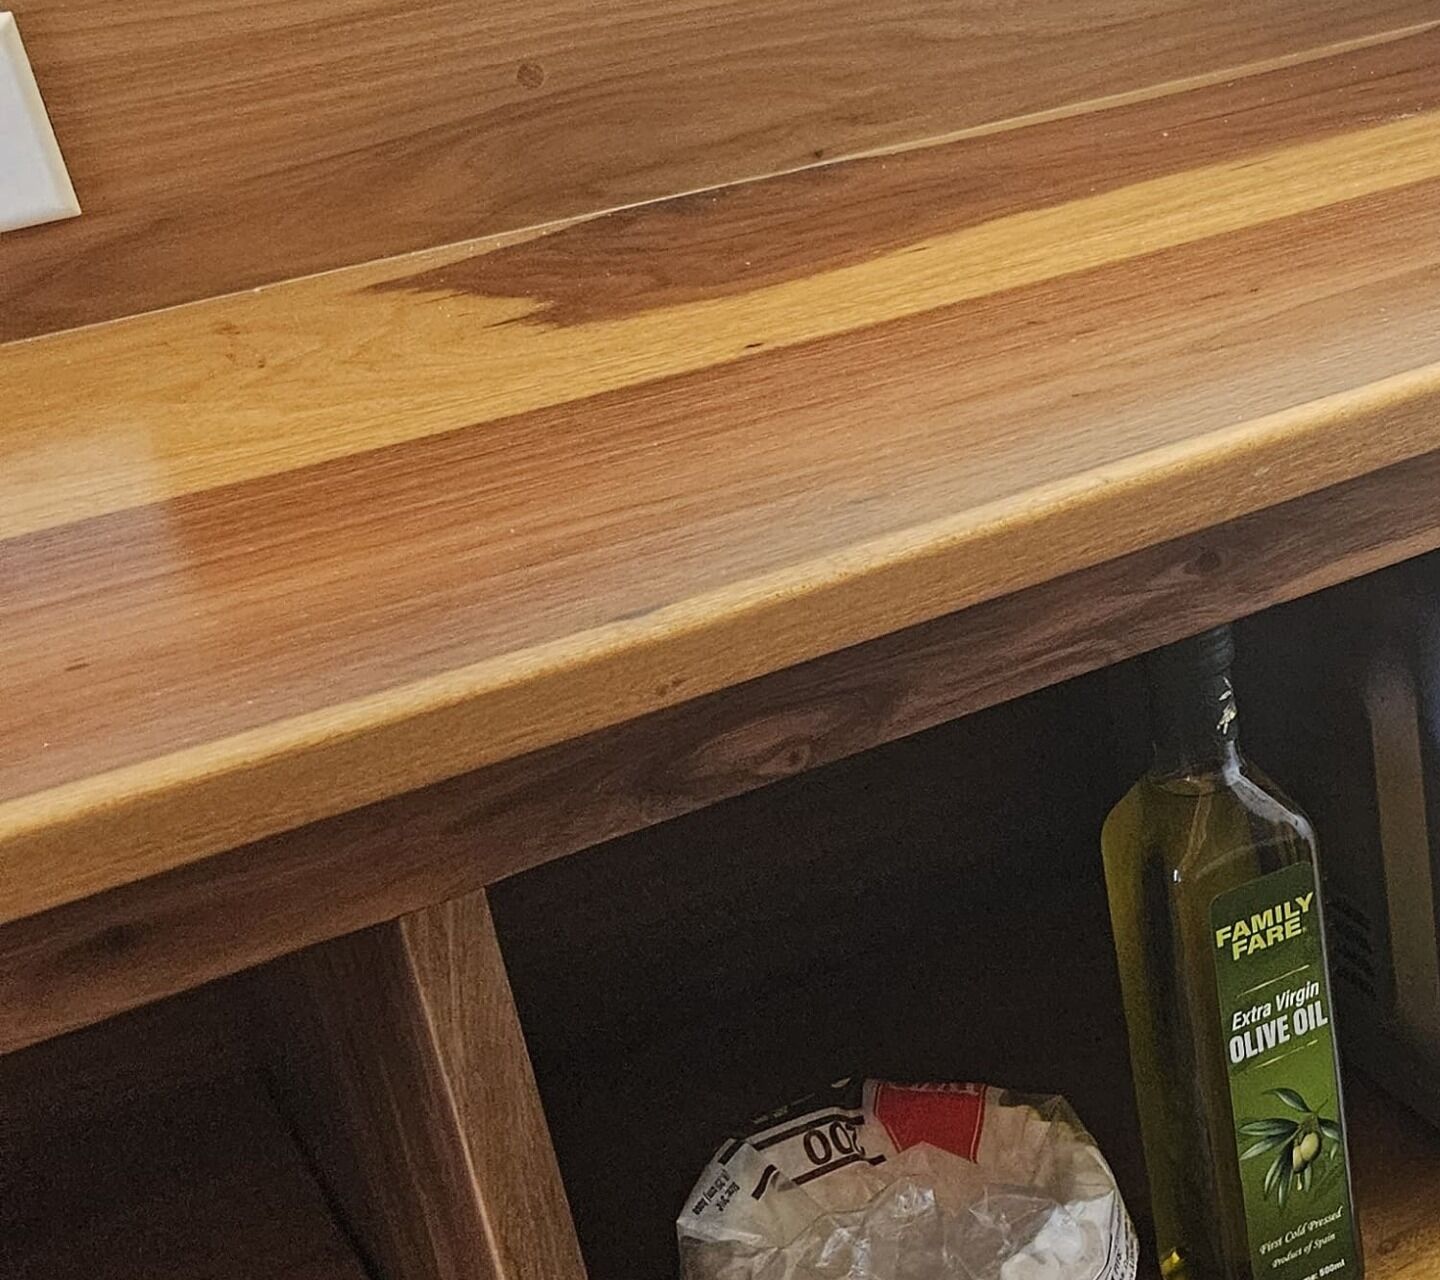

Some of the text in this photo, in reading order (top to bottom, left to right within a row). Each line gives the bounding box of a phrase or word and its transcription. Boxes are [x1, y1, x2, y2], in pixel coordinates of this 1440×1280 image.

[1215, 891, 1314, 948] FAMILY
[1231, 916, 1302, 961] FARE
[1231, 981, 1320, 1031] Extra Virgin
[1228, 1000, 1329, 1064] OLIVE OIL
[1259, 1206, 1343, 1255] First Cold Pressed
[1271, 1233, 1336, 1268] Product of Spain
